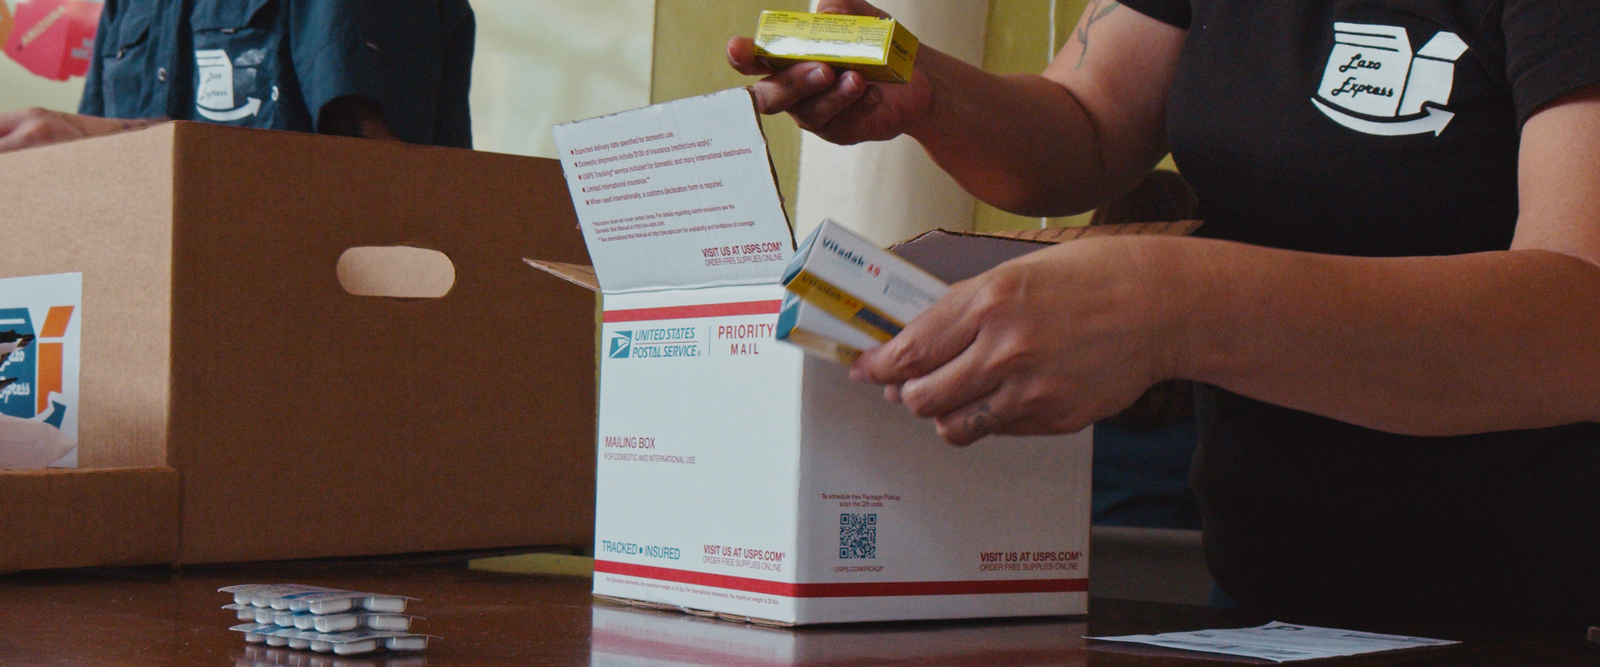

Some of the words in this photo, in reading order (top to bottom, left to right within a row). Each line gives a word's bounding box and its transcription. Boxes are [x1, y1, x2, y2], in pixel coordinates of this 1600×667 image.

[1338, 53, 1381, 72] Lazo
[1330, 76, 1394, 98] Express
[574, 146, 594, 156] Expected
[610, 140, 619, 148] date
[620, 137, 638, 147] specified
[645, 132, 665, 142] domestic
[578, 159, 598, 168] Domestic
[598, 155, 618, 165] shipments
[618, 152, 634, 160] include
[634, 150, 645, 158] $100
[650, 146, 670, 154] insurance
[582, 172, 594, 180] USPS
[614, 167, 629, 175] service
[629, 164, 647, 172] included
[654, 160, 674, 168] domestic
[683, 156, 696, 164] many
[696, 151, 722, 161] international
[586, 184, 602, 192] Limited
[602, 180, 626, 190] international
[602, 196, 612, 204] used
[664, 186, 688, 194] declaration
[701, 247, 720, 258] VISIT
[720, 246, 730, 256] US
[732, 246, 740, 255] AT
[704, 258, 722, 266] ORDER
[722, 257, 737, 266] FREE
[737, 254, 762, 264] SUPPLIES
[762, 253, 783, 262] ONLINE
[634, 329, 666, 341] UNITED
[666, 327, 696, 340] STATES
[632, 346, 662, 358] POSTAL
[730, 343, 759, 356] MAIL
[605, 436, 637, 448] MAILING
[638, 437, 656, 450] BOX
[604, 452, 614, 460] FOR
[614, 453, 638, 462] DOMESTIC
[638, 454, 648, 462] AND
[649, 454, 685, 464] INTERNATIONAL
[686, 456, 696, 464] USE
[602, 540, 638, 555] TRACKED
[644, 544, 680, 560] INSURED
[703, 544, 720, 556] VISIT
[722, 546, 732, 556] US
[732, 547, 743, 558] AT
[980, 552, 1004, 562] VISIT
[1005, 552, 1018, 562] US
[1019, 552, 1031, 562] AT
[702, 556, 721, 564] ORDER
[722, 558, 734, 566] FREE
[735, 559, 761, 569] SUPPLIES
[762, 561, 782, 572] ONLINE
[979, 563, 1004, 572] ORDER
[1004, 563, 1021, 571] FREE
[1022, 562, 1054, 571] SUPPLIES
[1055, 562, 1078, 570] ONLINE
